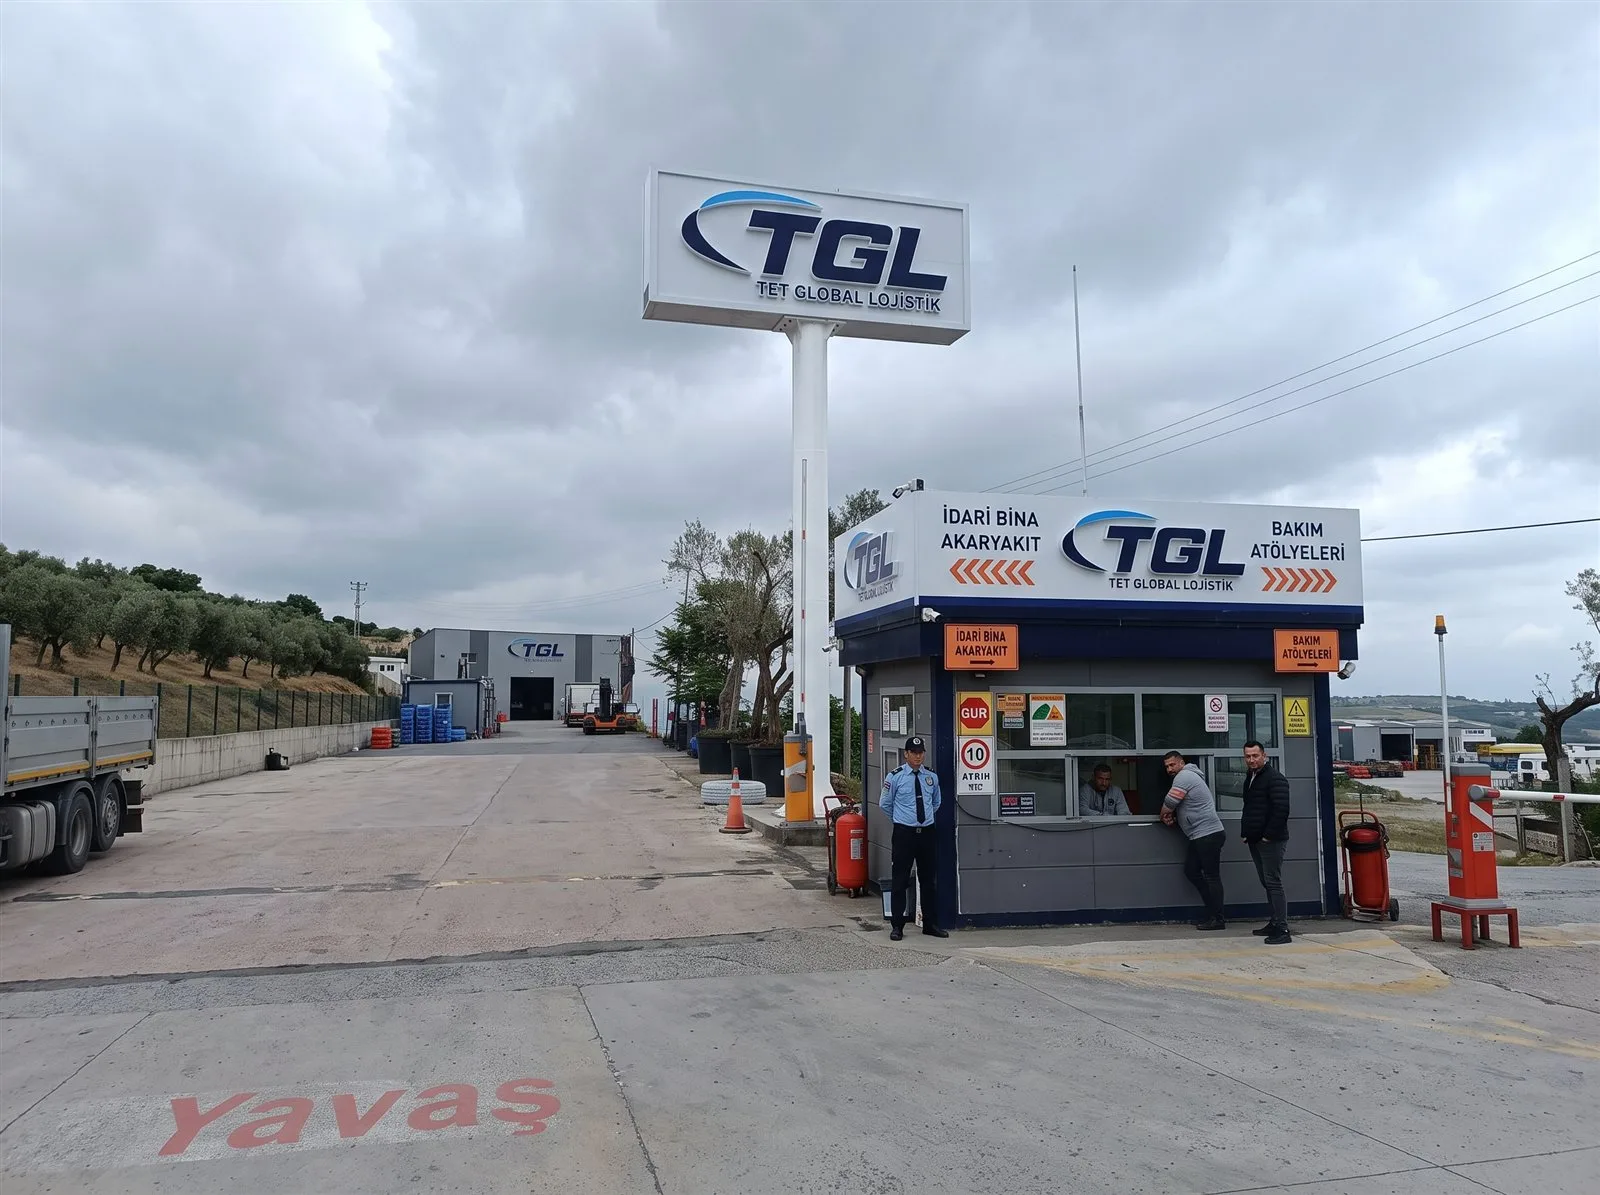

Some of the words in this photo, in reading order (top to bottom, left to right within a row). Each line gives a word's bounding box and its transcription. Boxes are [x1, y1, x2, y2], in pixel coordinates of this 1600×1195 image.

[748, 209, 948, 292] TGL
[757, 281, 789, 297] TET
[794, 285, 864, 305] GLOBAL
[869, 291, 941, 312] LOJİSTİK
[943, 504, 990, 526] İDARİ
[996, 506, 1039, 527] BİNA
[1272, 521, 1323, 538] BAKIM
[941, 533, 1041, 552] AKARYAKIT
[1105, 525, 1246, 576] TGL
[1250, 541, 1345, 561] ATÖLYELERİ
[855, 531, 893, 588] TGL
[1109, 578, 1130, 589] TET
[1133, 579, 1180, 590] GLOBAL
[1183, 579, 1233, 591] LOJİSTİK
[956, 627, 982, 642] İDARİ
[984, 628, 1006, 642] BİNA
[1292, 635, 1320, 646] BAKIM
[523, 644, 564, 657] TGL
[955, 645, 1008, 657] AKARYAKIT
[1282, 646, 1332, 660] ATÖLYELERİ
[966, 747, 984, 761] 10
[157, 1078, 562, 1157] Yavaş
